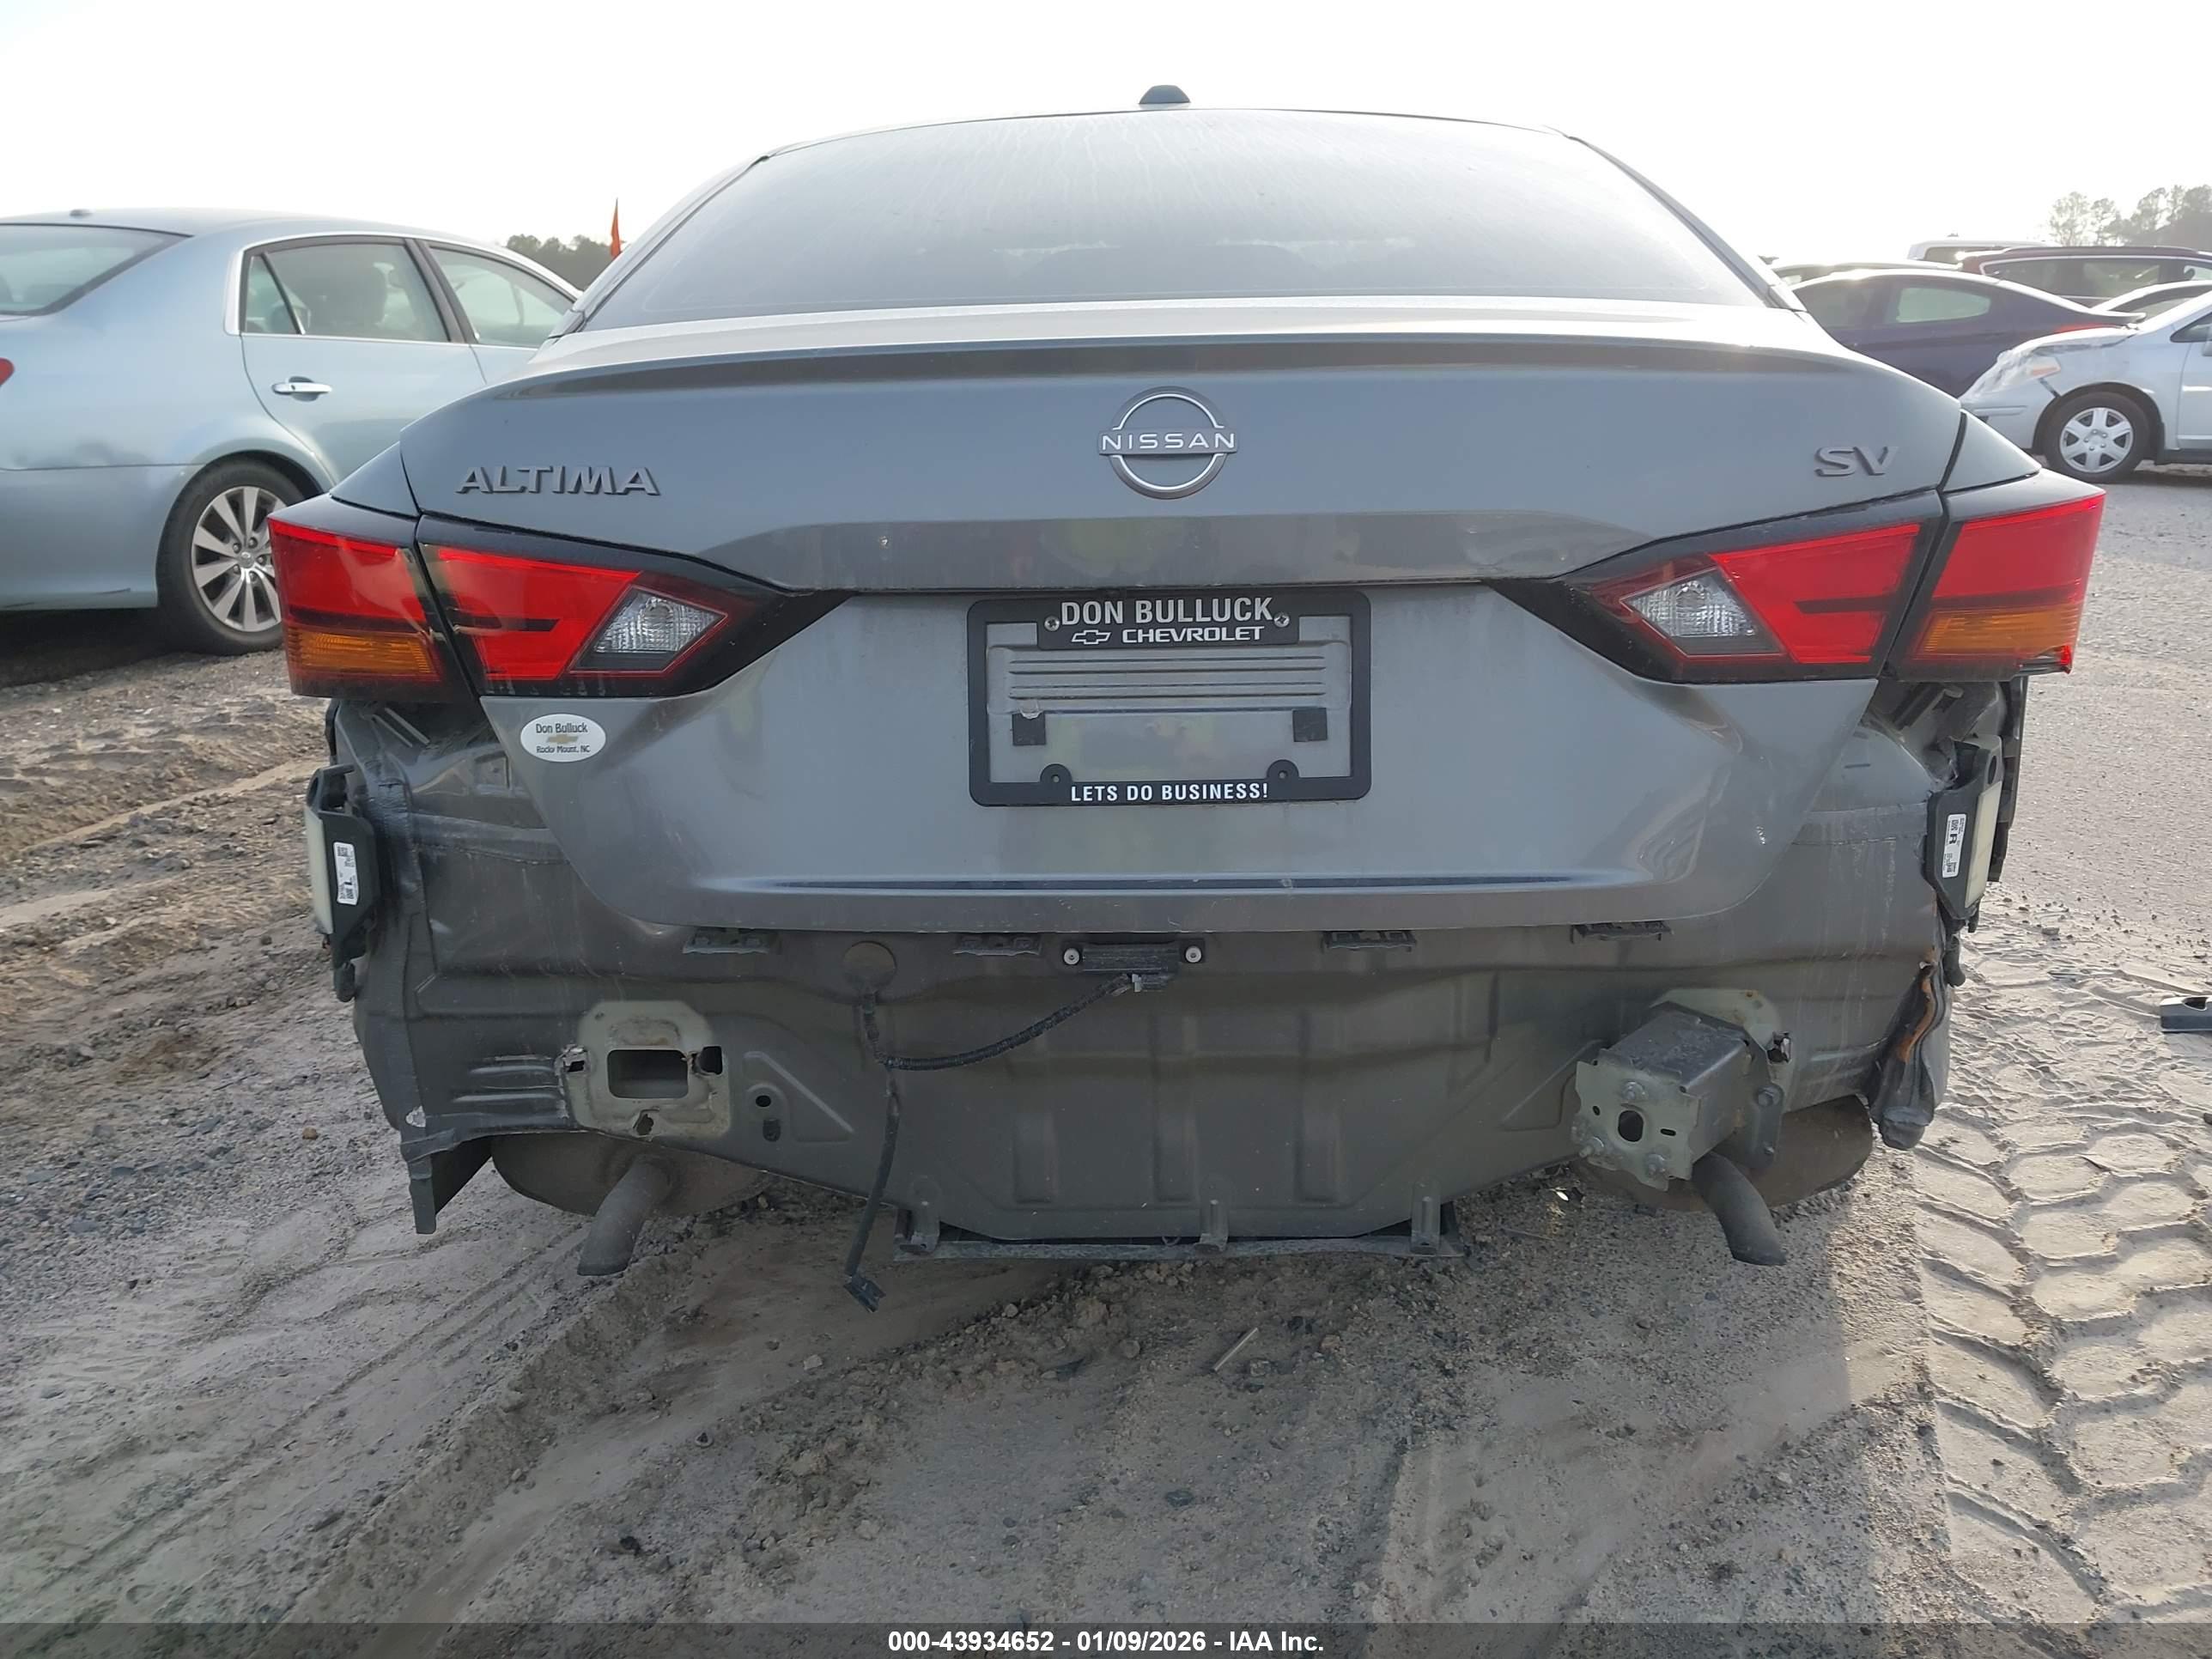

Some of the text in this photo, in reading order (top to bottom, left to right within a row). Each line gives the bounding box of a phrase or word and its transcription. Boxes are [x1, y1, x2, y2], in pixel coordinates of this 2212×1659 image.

[1102, 432, 1235, 451] NISSAN
[1813, 446, 1899, 477] SV
[455, 465, 661, 495] ALTIMA
[1060, 597, 1273, 626] DON BULLUCK
[1121, 626, 1265, 643] CHEVROLET
[535, 722, 589, 734] Don Bulluck
[1071, 782, 1269, 802] LETS DO BUSINESS!
